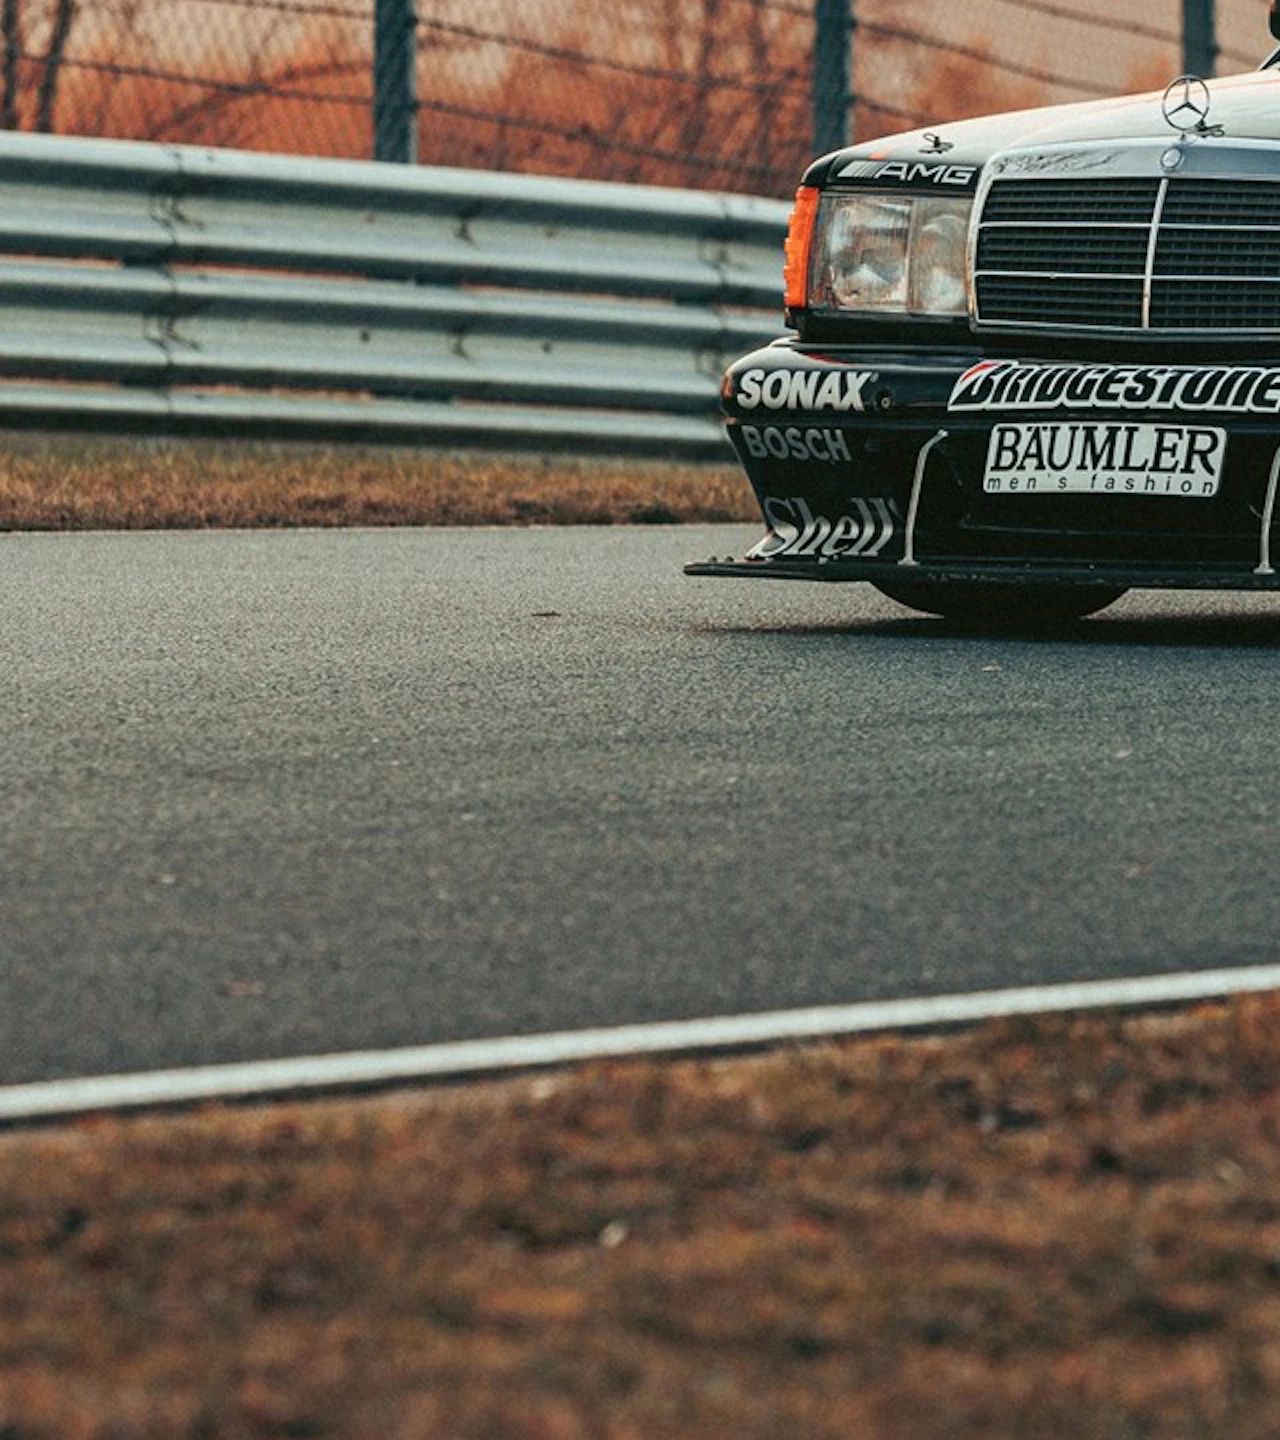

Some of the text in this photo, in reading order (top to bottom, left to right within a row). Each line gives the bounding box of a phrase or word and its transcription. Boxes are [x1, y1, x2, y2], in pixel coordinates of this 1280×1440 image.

[872, 161, 978, 185] AMG
[741, 425, 852, 461] BOSCH
[990, 426, 1218, 476] BÄUMLER
[987, 474, 1214, 495] men's fashion
[745, 497, 894, 559] Shell
